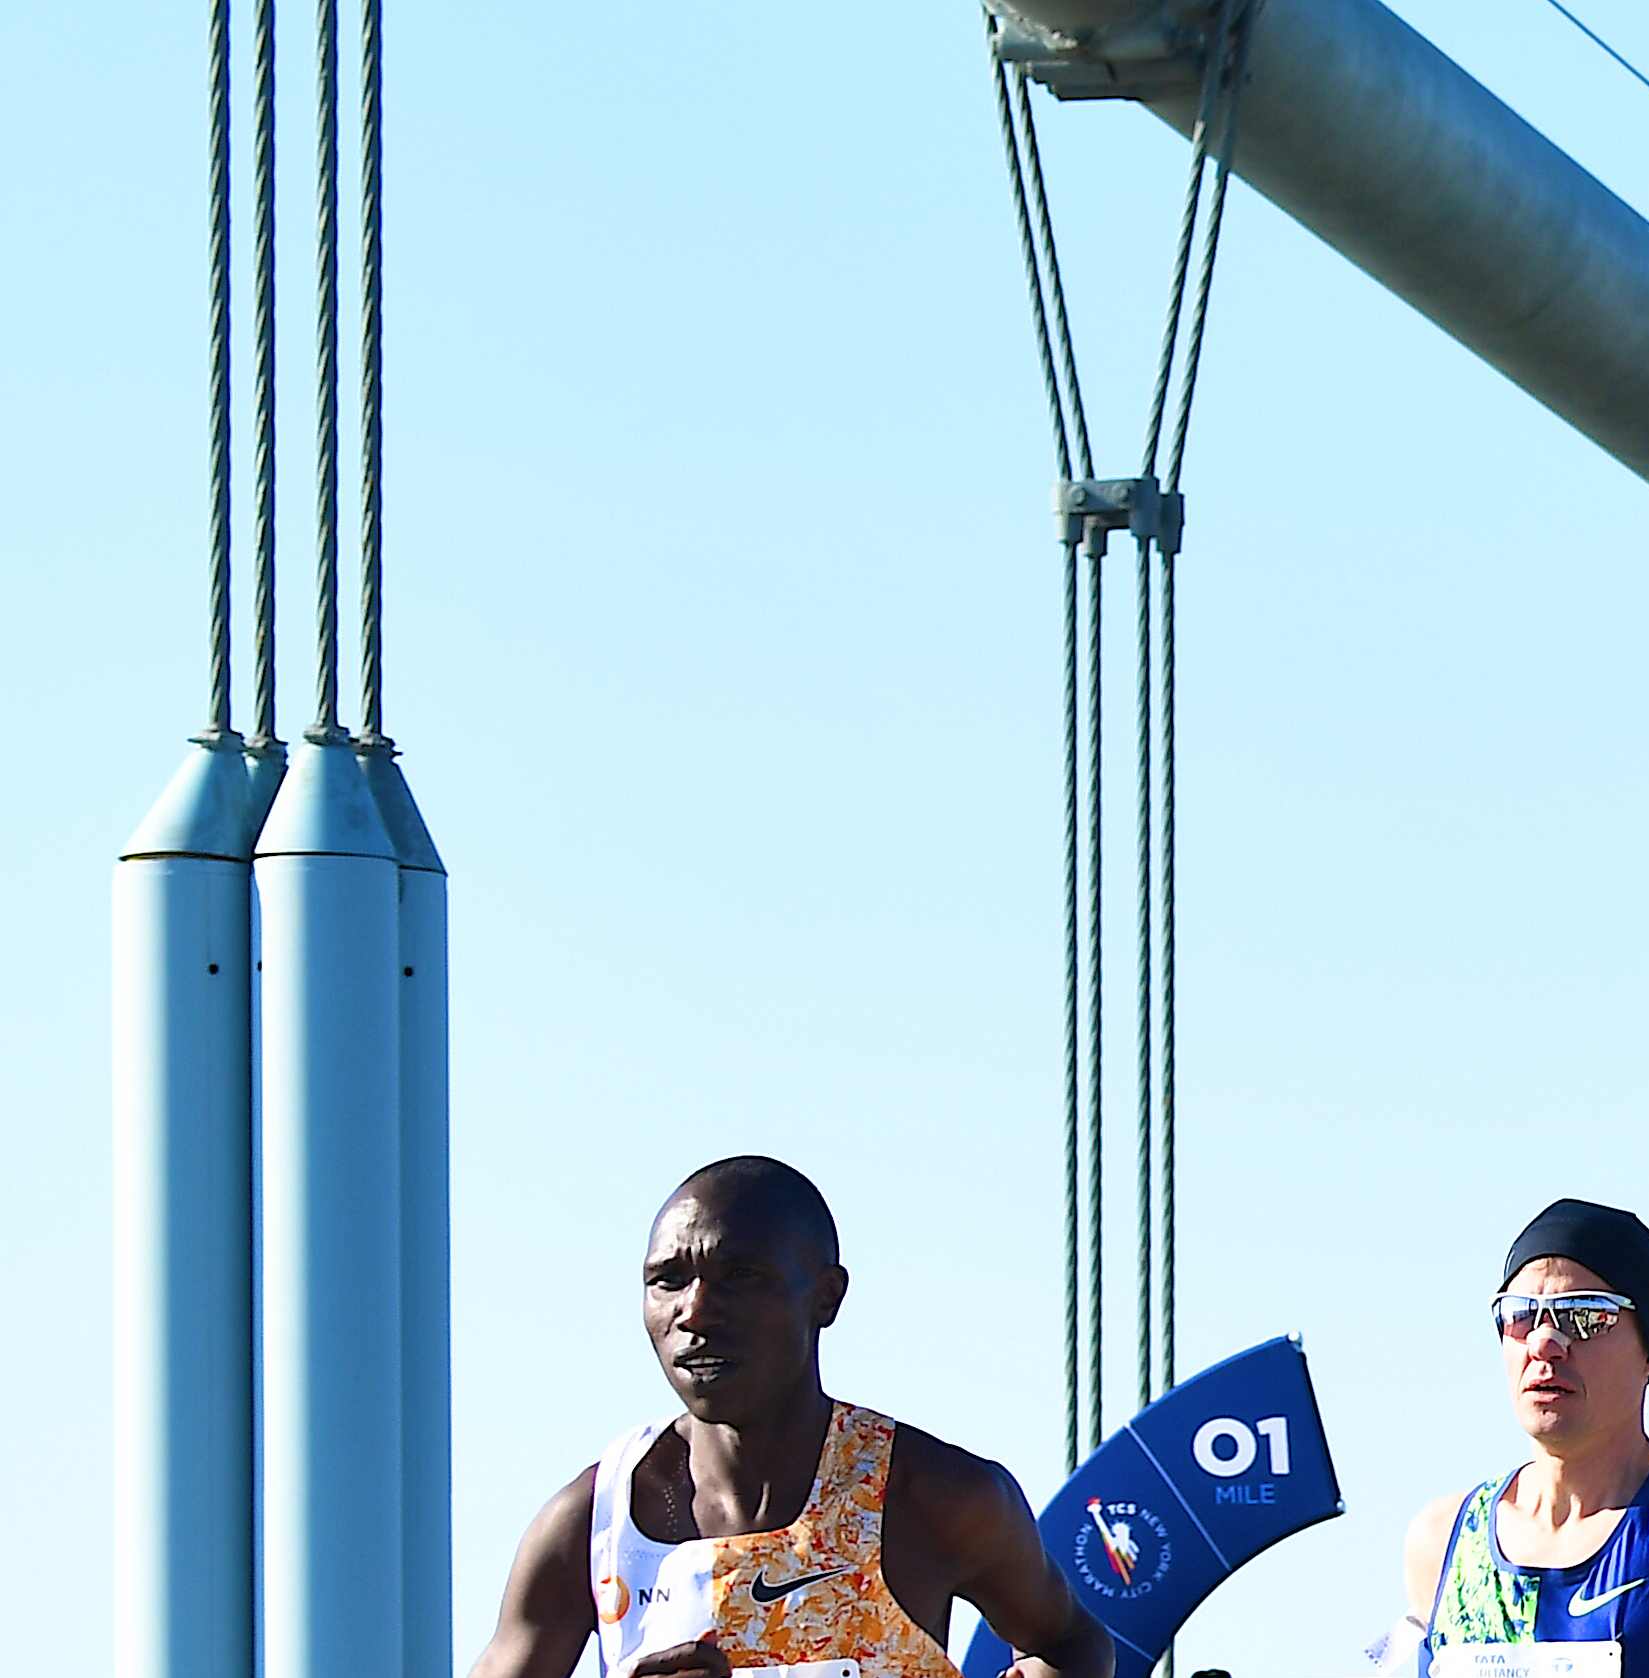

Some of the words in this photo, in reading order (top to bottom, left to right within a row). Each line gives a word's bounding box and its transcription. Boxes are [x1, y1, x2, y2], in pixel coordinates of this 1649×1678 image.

[1193, 1417, 1290, 1477] 01
[1215, 1484, 1276, 1505] MILE
[1106, 1503, 1136, 1515] TCS
[1140, 1509, 1168, 1537] NEW
[1074, 1523, 1114, 1597] MARATHON
[638, 1588, 670, 1606] NN
